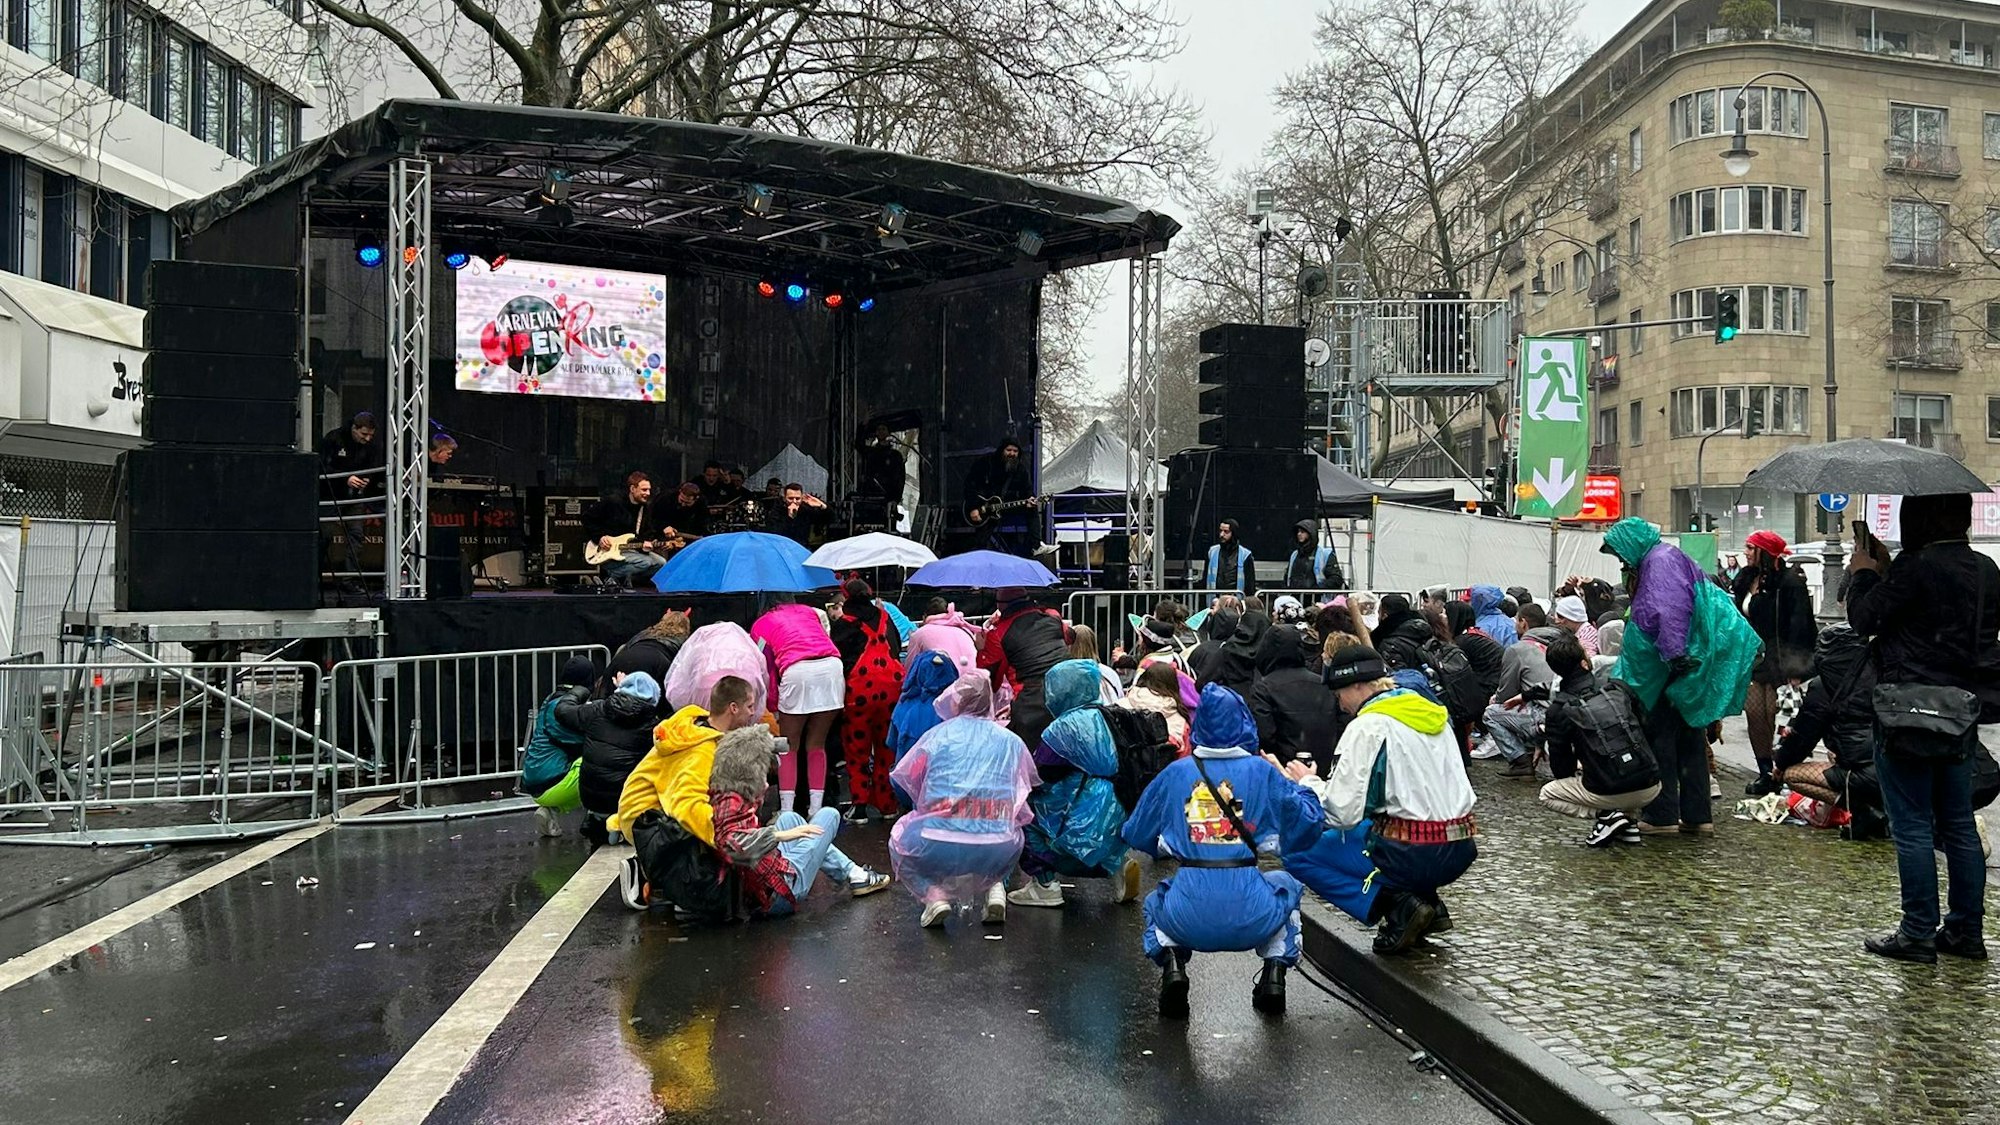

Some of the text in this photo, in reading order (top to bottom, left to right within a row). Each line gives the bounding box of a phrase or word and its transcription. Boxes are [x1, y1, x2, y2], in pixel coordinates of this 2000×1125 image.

[495, 310, 563, 332] KARNEVAL
[494, 331, 565, 357] OPEN
[561, 363, 573, 373] AUF
[575, 364, 589, 374] DEM
[591, 364, 616, 375] KÖLNER
[1584, 489, 1615, 497] LOSSEN
[554, 519, 583, 527] STADTRA
